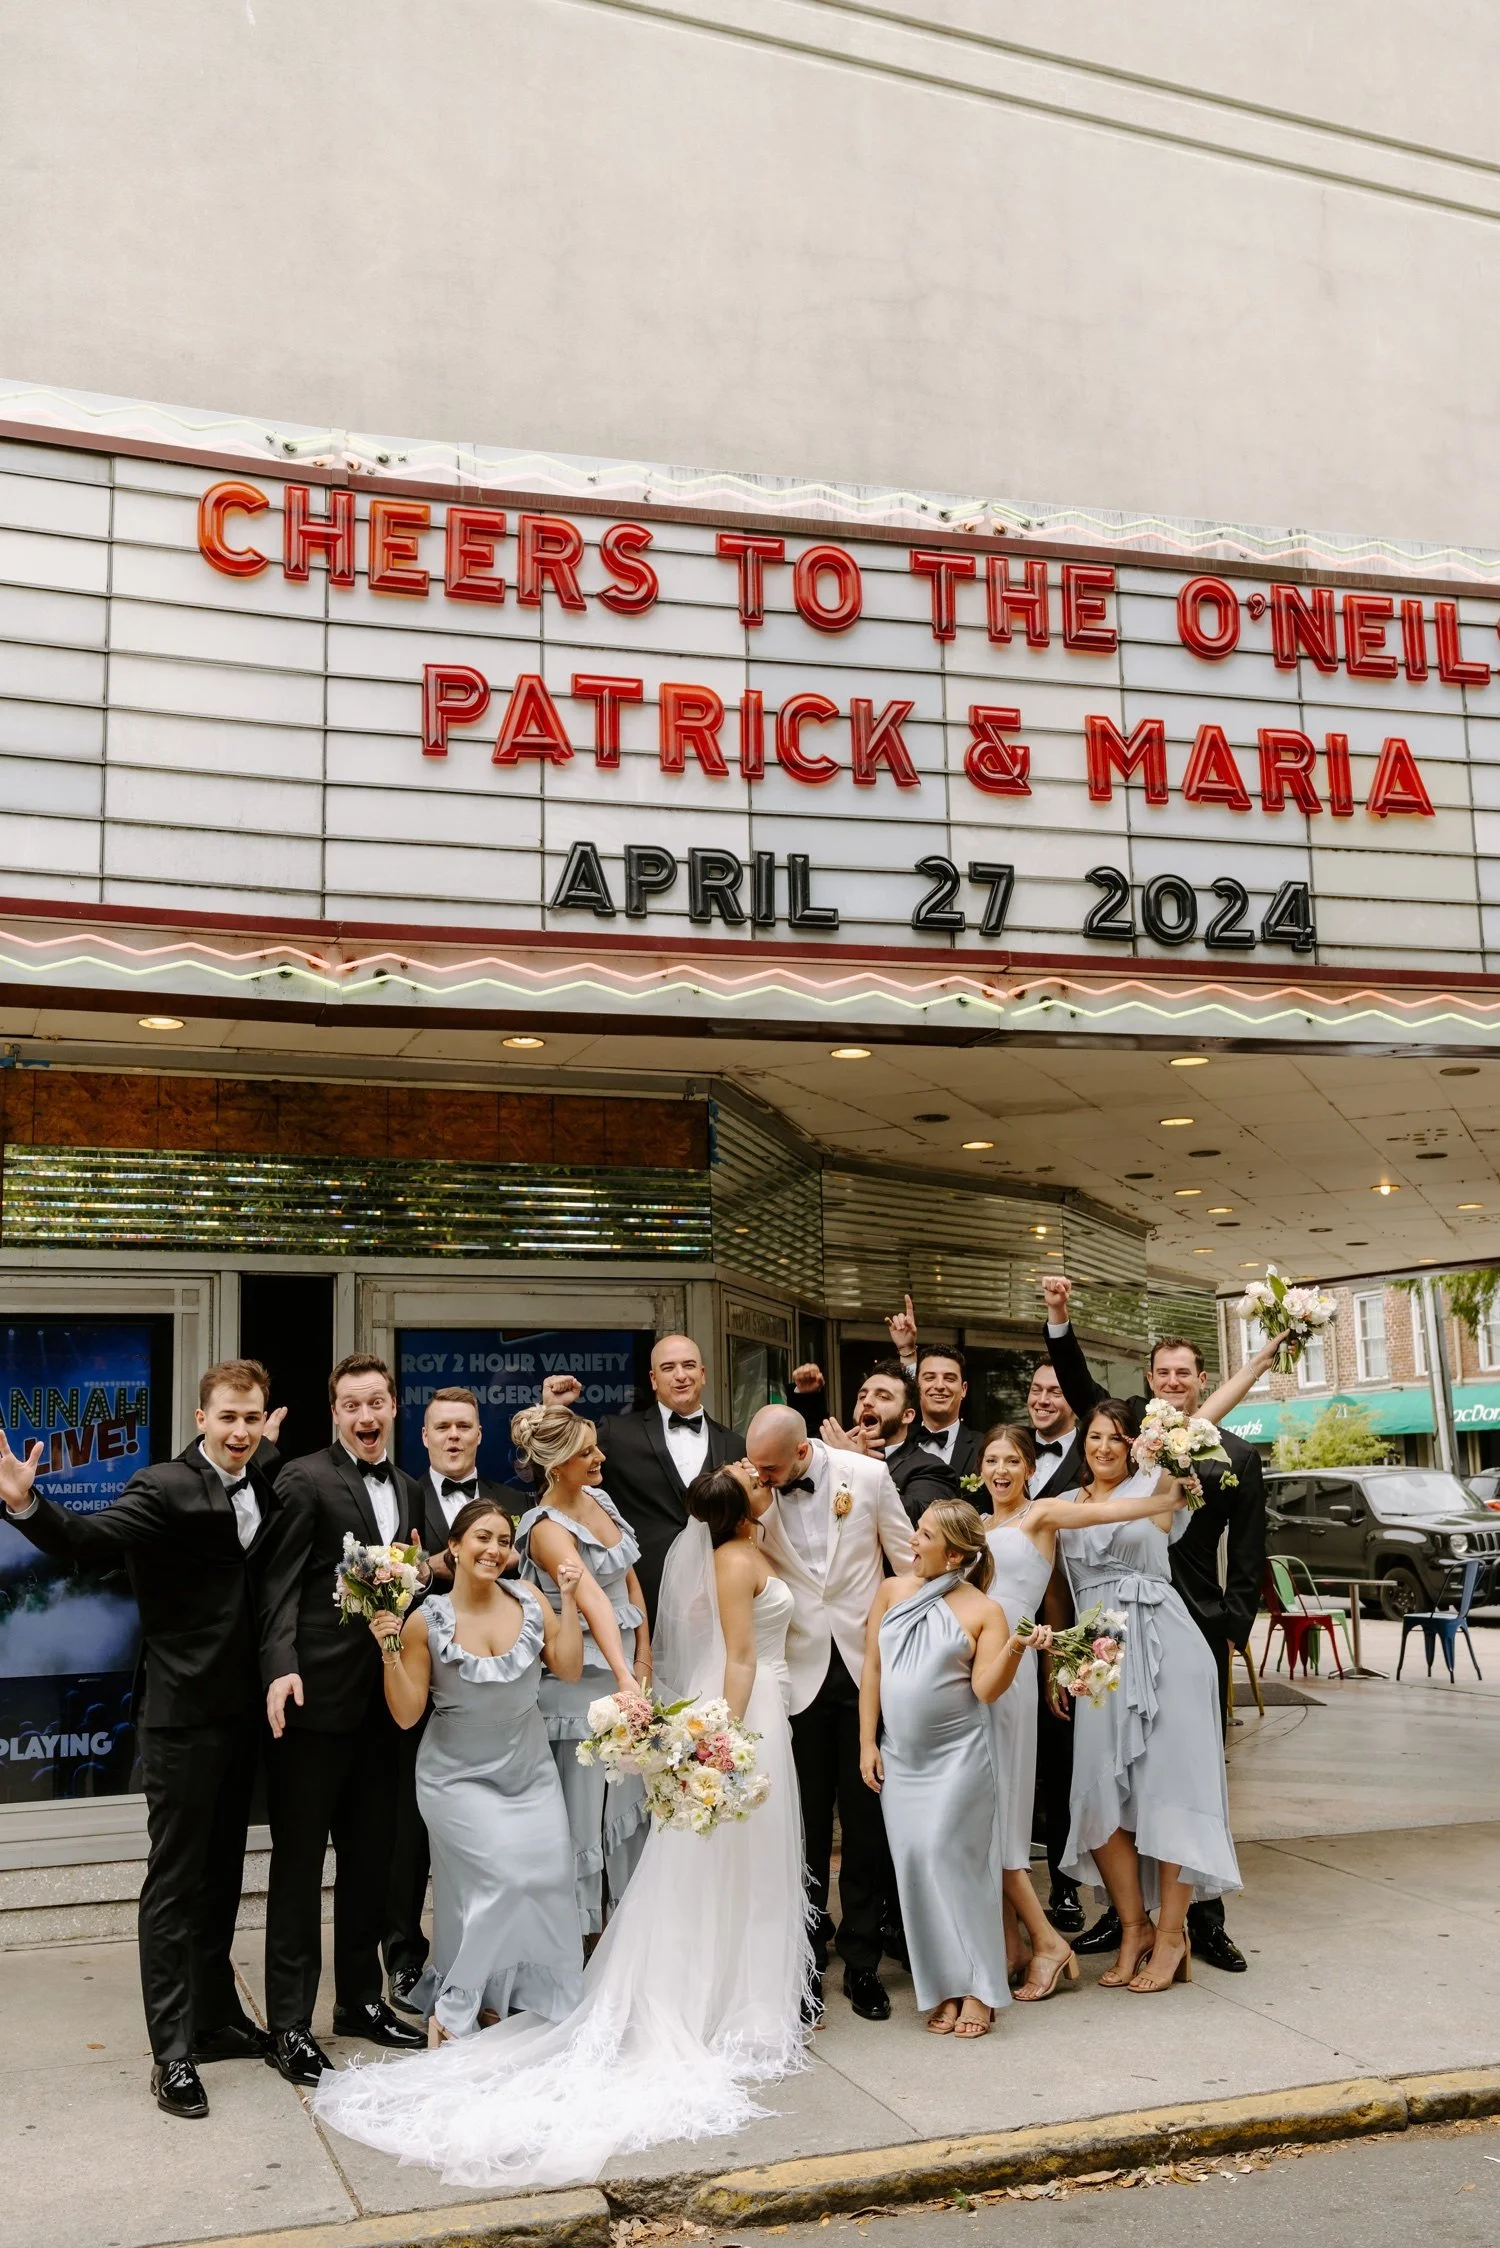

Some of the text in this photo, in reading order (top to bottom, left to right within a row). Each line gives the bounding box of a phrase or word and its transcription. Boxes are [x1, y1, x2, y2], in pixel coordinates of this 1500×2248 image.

[198, 480, 1500, 686] CHEERS TO THE O'NEIL
[421, 663, 1436, 818] PATRICK & MARIA
[547, 841, 1317, 953] APRIL 27 2024
[452, 1353, 465, 1372] 2
[469, 1353, 536, 1372] HOUR
[540, 1352, 631, 1372] VARIETY
[0, 1387, 149, 1428] NNAH
[401, 1386, 436, 1405] ND
[467, 1385, 544, 1404] NGERS
[24, 1410, 140, 1477] LIVE!
[46, 1482, 99, 1494] VARIETY
[100, 1481, 129, 1494] SHO
